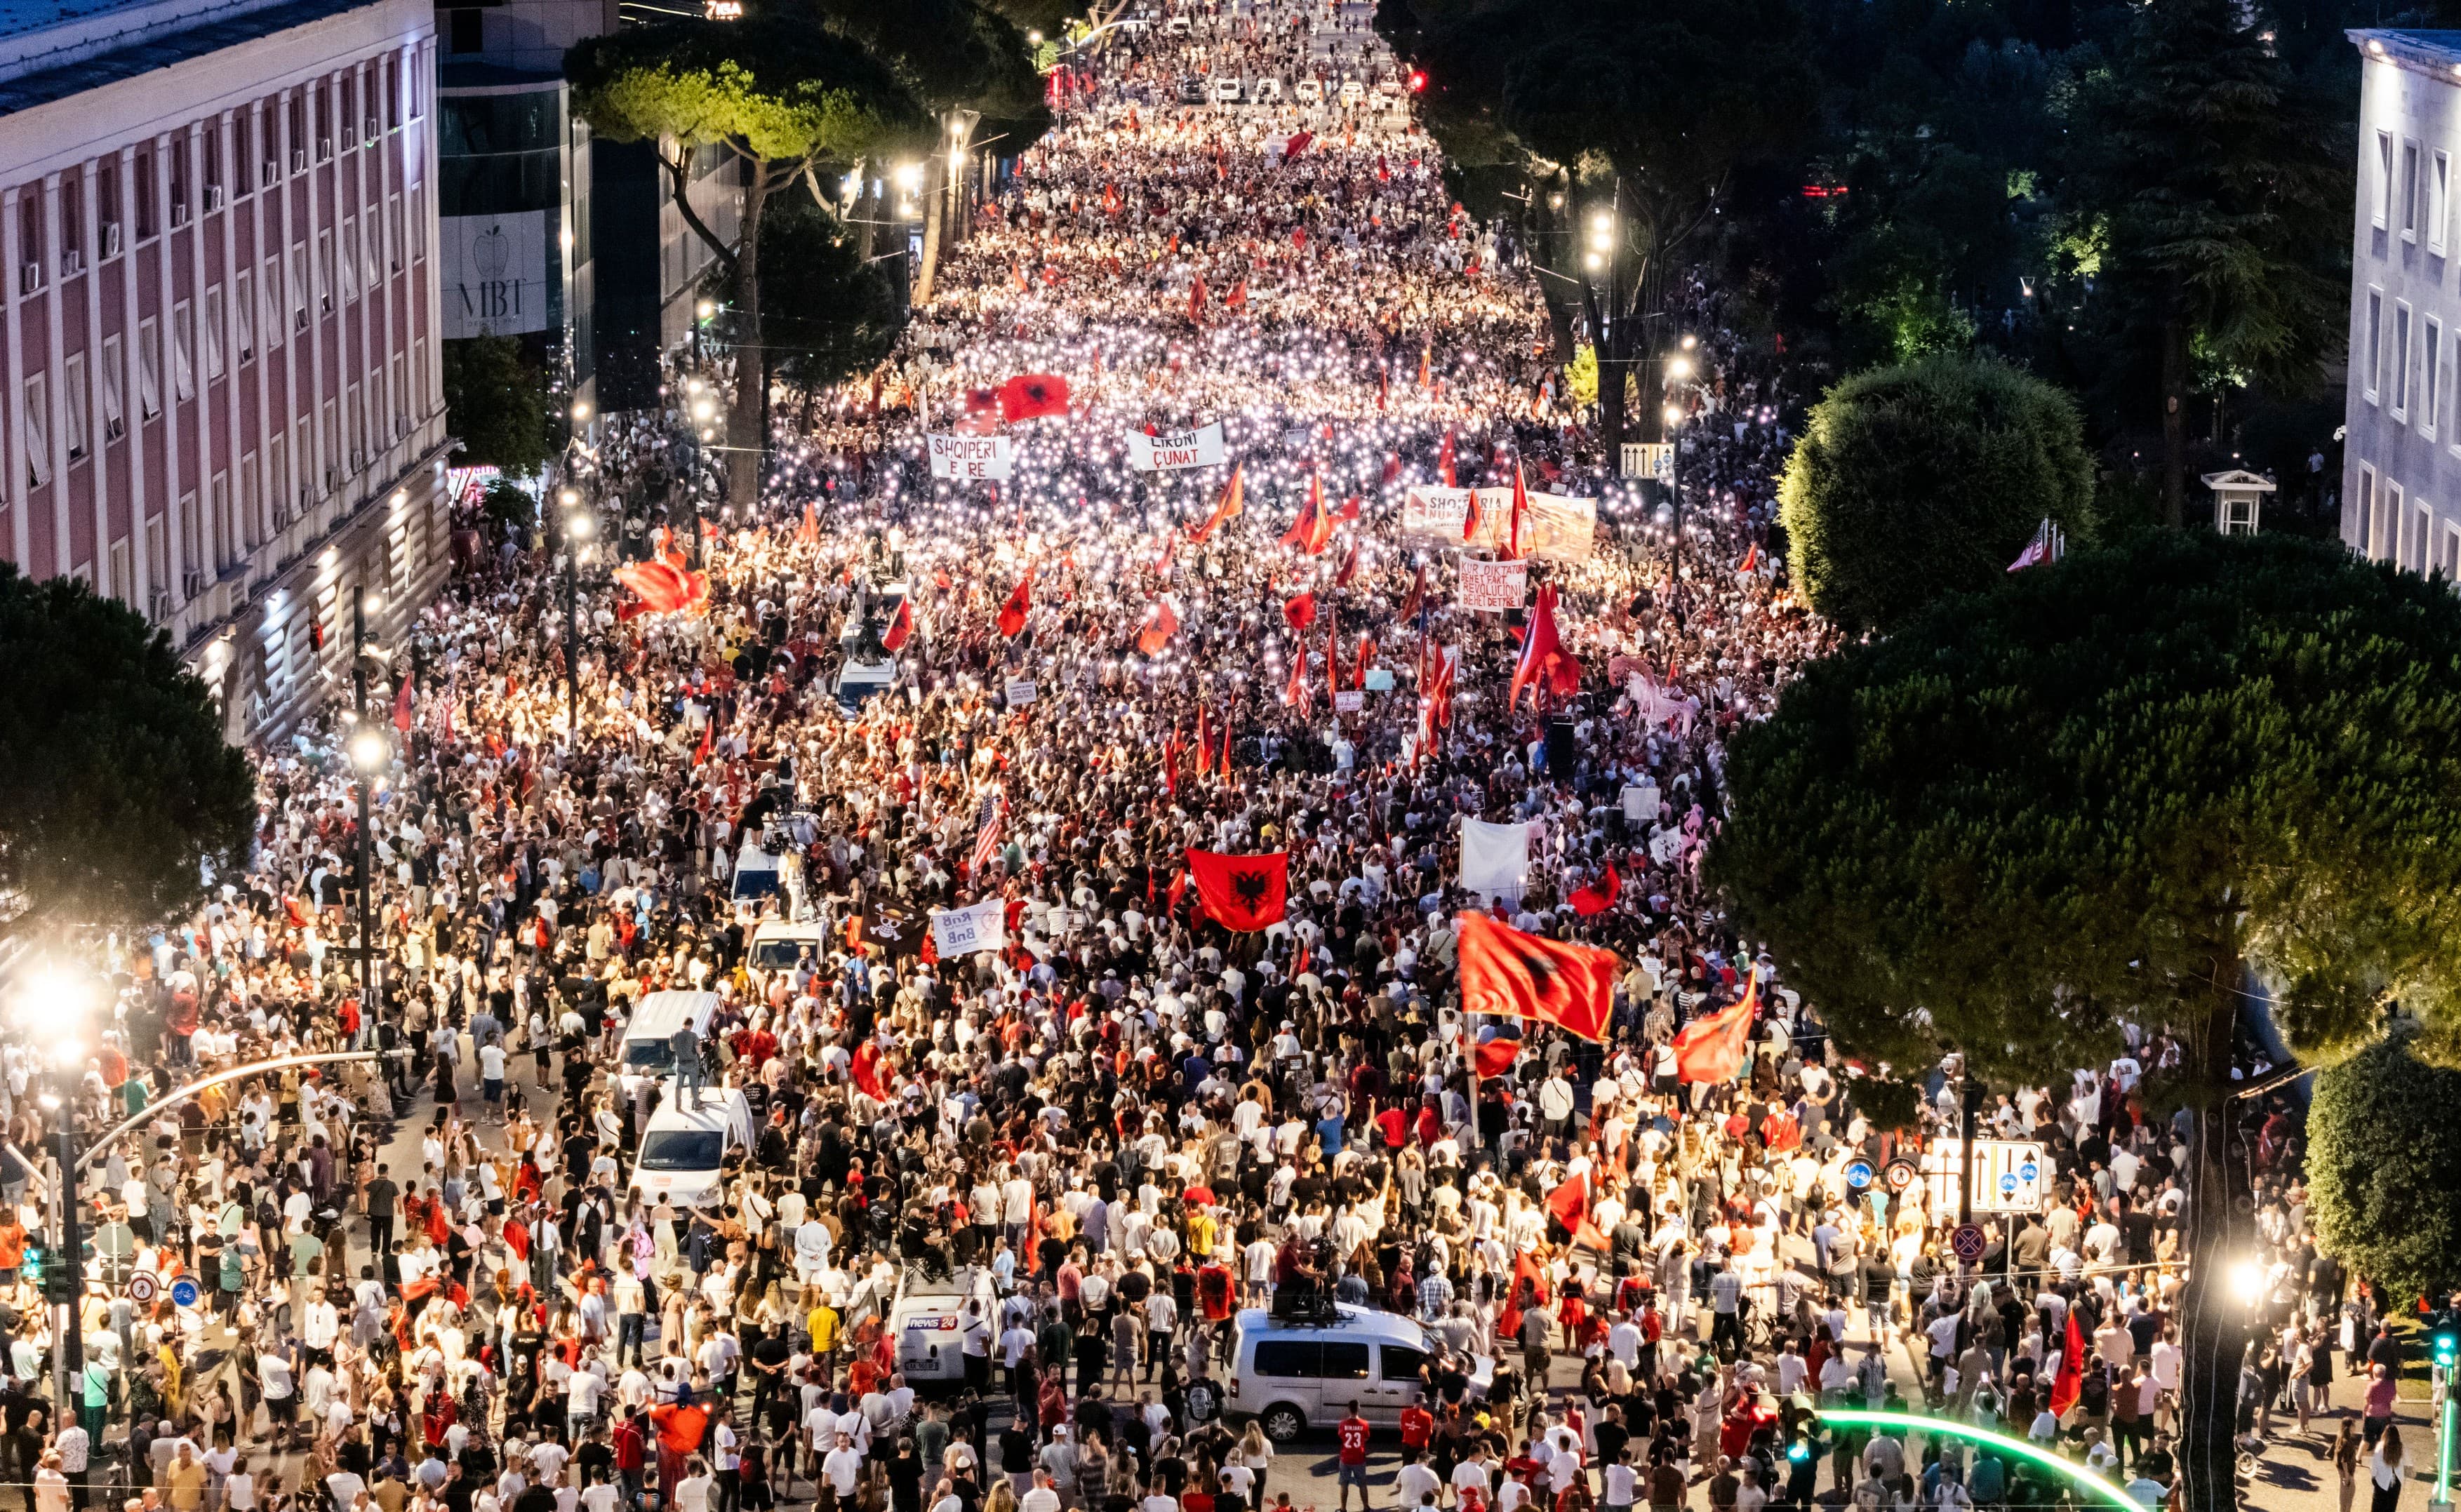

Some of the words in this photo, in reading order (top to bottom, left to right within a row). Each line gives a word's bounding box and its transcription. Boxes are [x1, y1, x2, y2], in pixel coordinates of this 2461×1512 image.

[458, 279, 526, 320] MBT
[935, 438, 996, 460] SHQIPËRI
[1154, 449, 1199, 469] ÇUNAT
[950, 461, 958, 474] E
[968, 462, 986, 477] RE
[1461, 561, 1479, 574] KUR
[1484, 563, 1527, 575] DIKTATURA
[1463, 594, 1486, 606] BEHET
[910, 1318, 939, 1327] news
[941, 1317, 955, 1327] 24
[1344, 1432, 1361, 1448] 23
